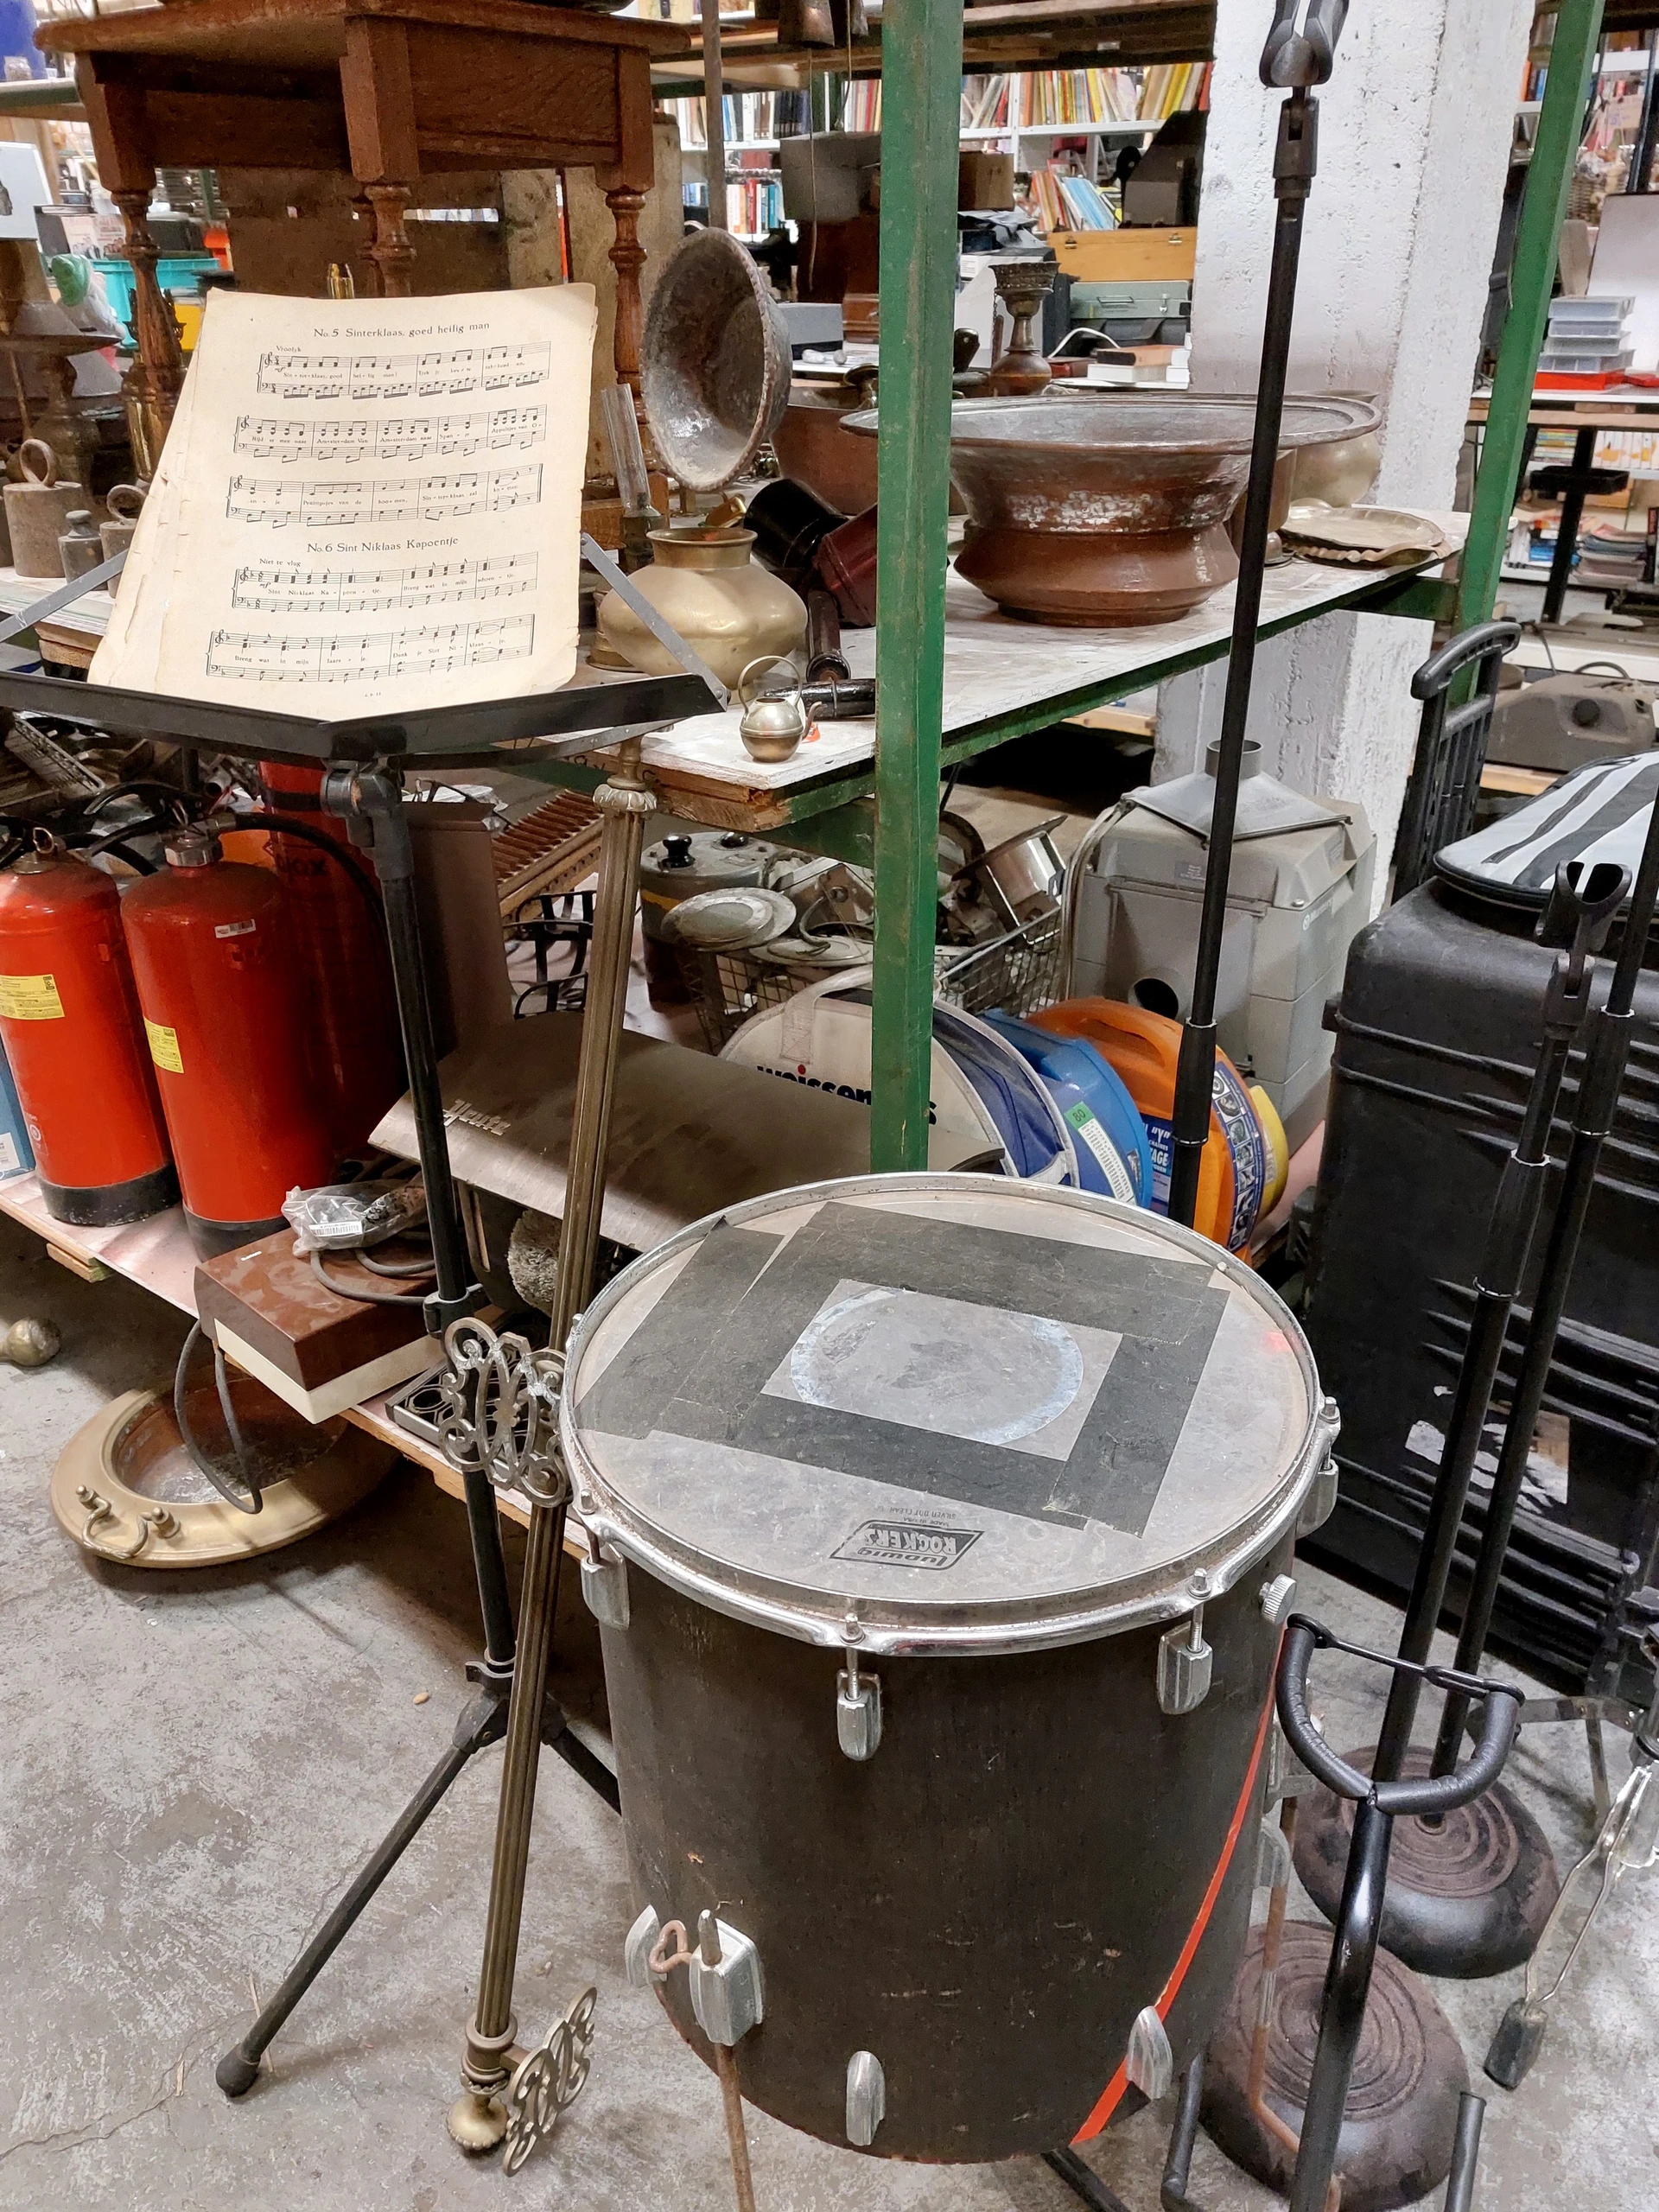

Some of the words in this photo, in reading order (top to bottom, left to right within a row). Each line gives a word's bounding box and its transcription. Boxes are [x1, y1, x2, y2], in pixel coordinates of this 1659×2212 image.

[346, 327, 405, 337] Sinterklaas,
[409, 326, 433, 337] goed
[437, 324, 464, 334] heilig
[469, 322, 490, 331] man
[336, 542, 358, 552] Sint
[361, 542, 401, 552] Niklaas
[406, 537, 459, 550] Kapoentje
[1072, 1109, 1086, 1122] 80
